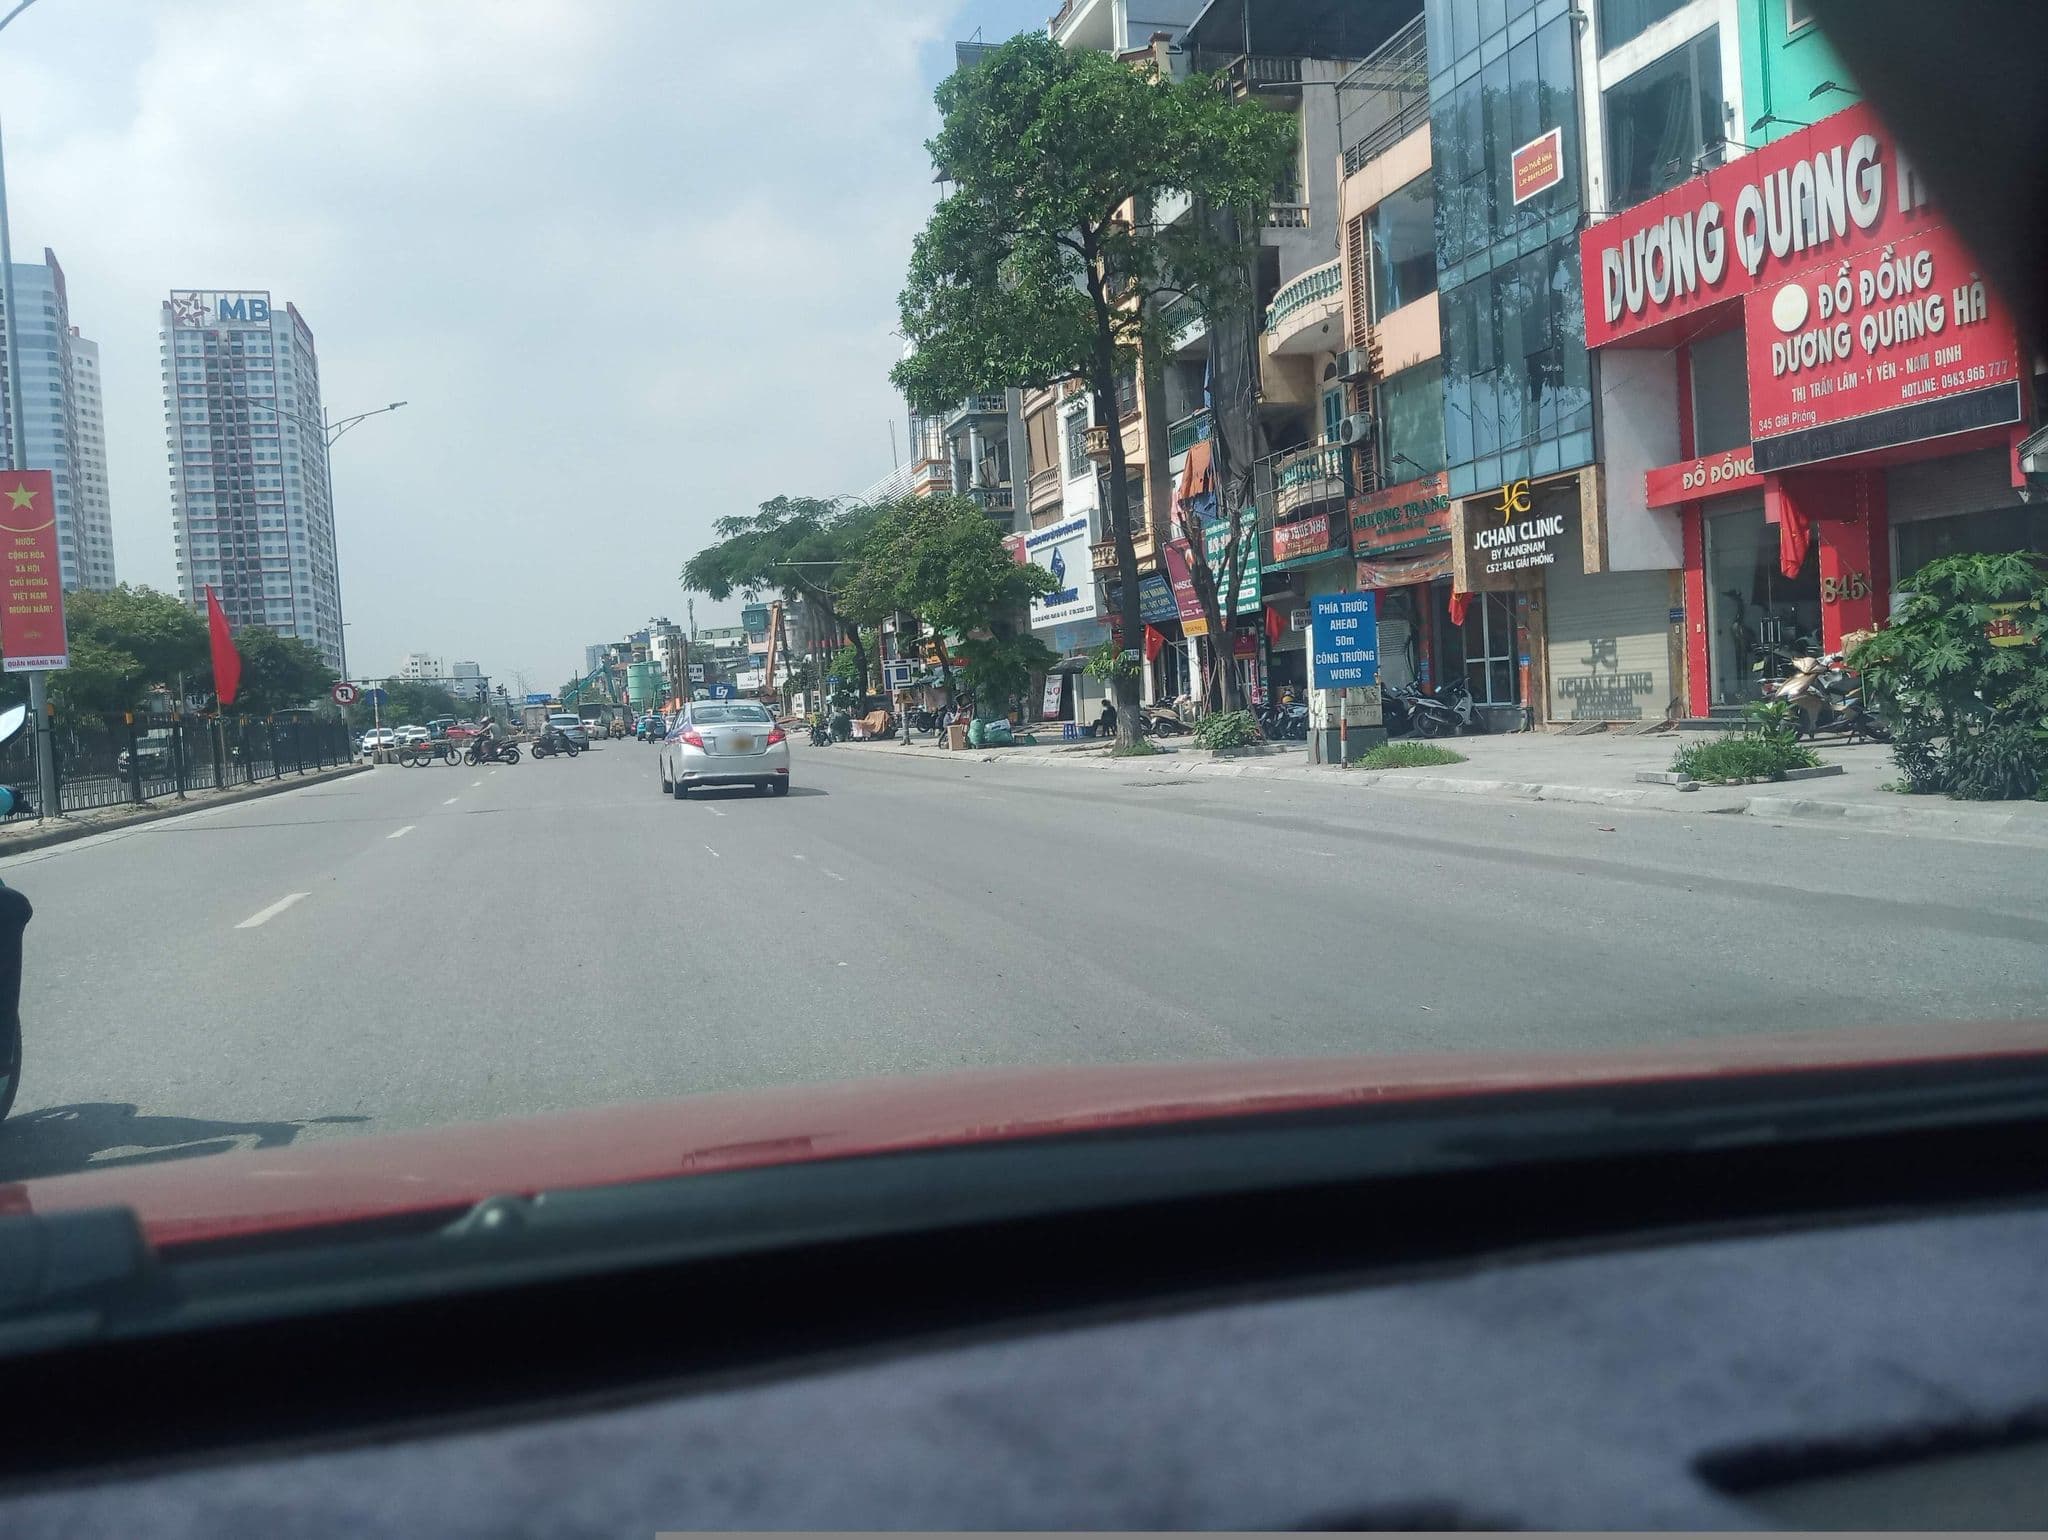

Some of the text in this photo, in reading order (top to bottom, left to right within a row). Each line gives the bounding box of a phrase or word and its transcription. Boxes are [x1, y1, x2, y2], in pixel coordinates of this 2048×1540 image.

[1601, 202, 1726, 323] DƯƠNG
[1734, 135, 1883, 275] QUANG
[1818, 245, 1933, 320] ĐỒ ĐỒNG
[220, 298, 269, 322] MB
[1772, 273, 1989, 377] DƯƠNG QUANG HÀ
[1792, 386, 1807, 403] THỊ
[1809, 376, 1834, 398] TRẤN
[1837, 372, 1858, 391] LÂM
[1876, 361, 1897, 382] YÊN
[1906, 352, 1930, 375] NAM
[1935, 344, 1962, 368] ĐỊNH
[1775, 413, 1790, 428] Giải
[1682, 452, 1755, 490] ĐỒ ĐỒNG
[1473, 515, 1564, 550] JCHAN CLINIC
[1491, 541, 1546, 560] BY KANGNAM
[1516, 555, 1530, 568] GIẢI
[30, 592, 48, 600] NAM
[1823, 571, 1865, 603] 845
[1318, 598, 1369, 615] PHÍA TRƯỚC
[1330, 618, 1358, 631] AHEAD
[1335, 635, 1355, 647] 50m
[1315, 648, 1375, 665] CÔNG TRƯỜNG
[1330, 668, 1362, 680] WORKS
